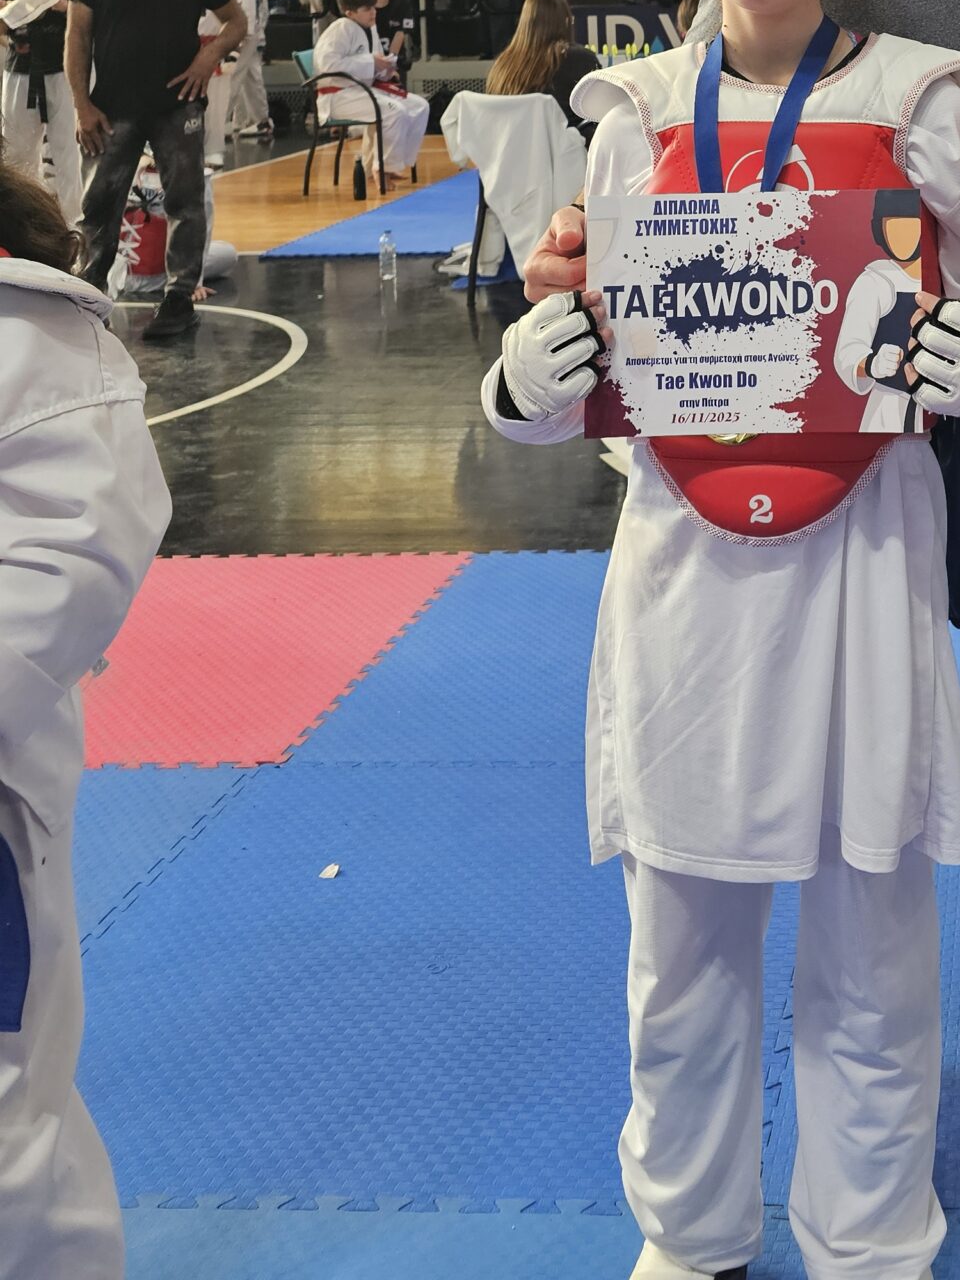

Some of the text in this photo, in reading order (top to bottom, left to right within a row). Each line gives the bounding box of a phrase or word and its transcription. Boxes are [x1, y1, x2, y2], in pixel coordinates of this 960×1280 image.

[653, 199, 720, 215] ΔΙΠΛΩΜΑ
[635, 218, 738, 236] ΣΥΜΜΕΤΟΧΗΣ
[603, 279, 839, 319] TAEKWONDO
[744, 353, 767, 363] στους
[767, 352, 799, 363] Αγώνες
[655, 370, 758, 389] Tae Kwon Do
[679, 397, 729, 409] στην Πάτρα
[671, 411, 741, 424] 16/11/2025
[748, 494, 774, 524] 2
